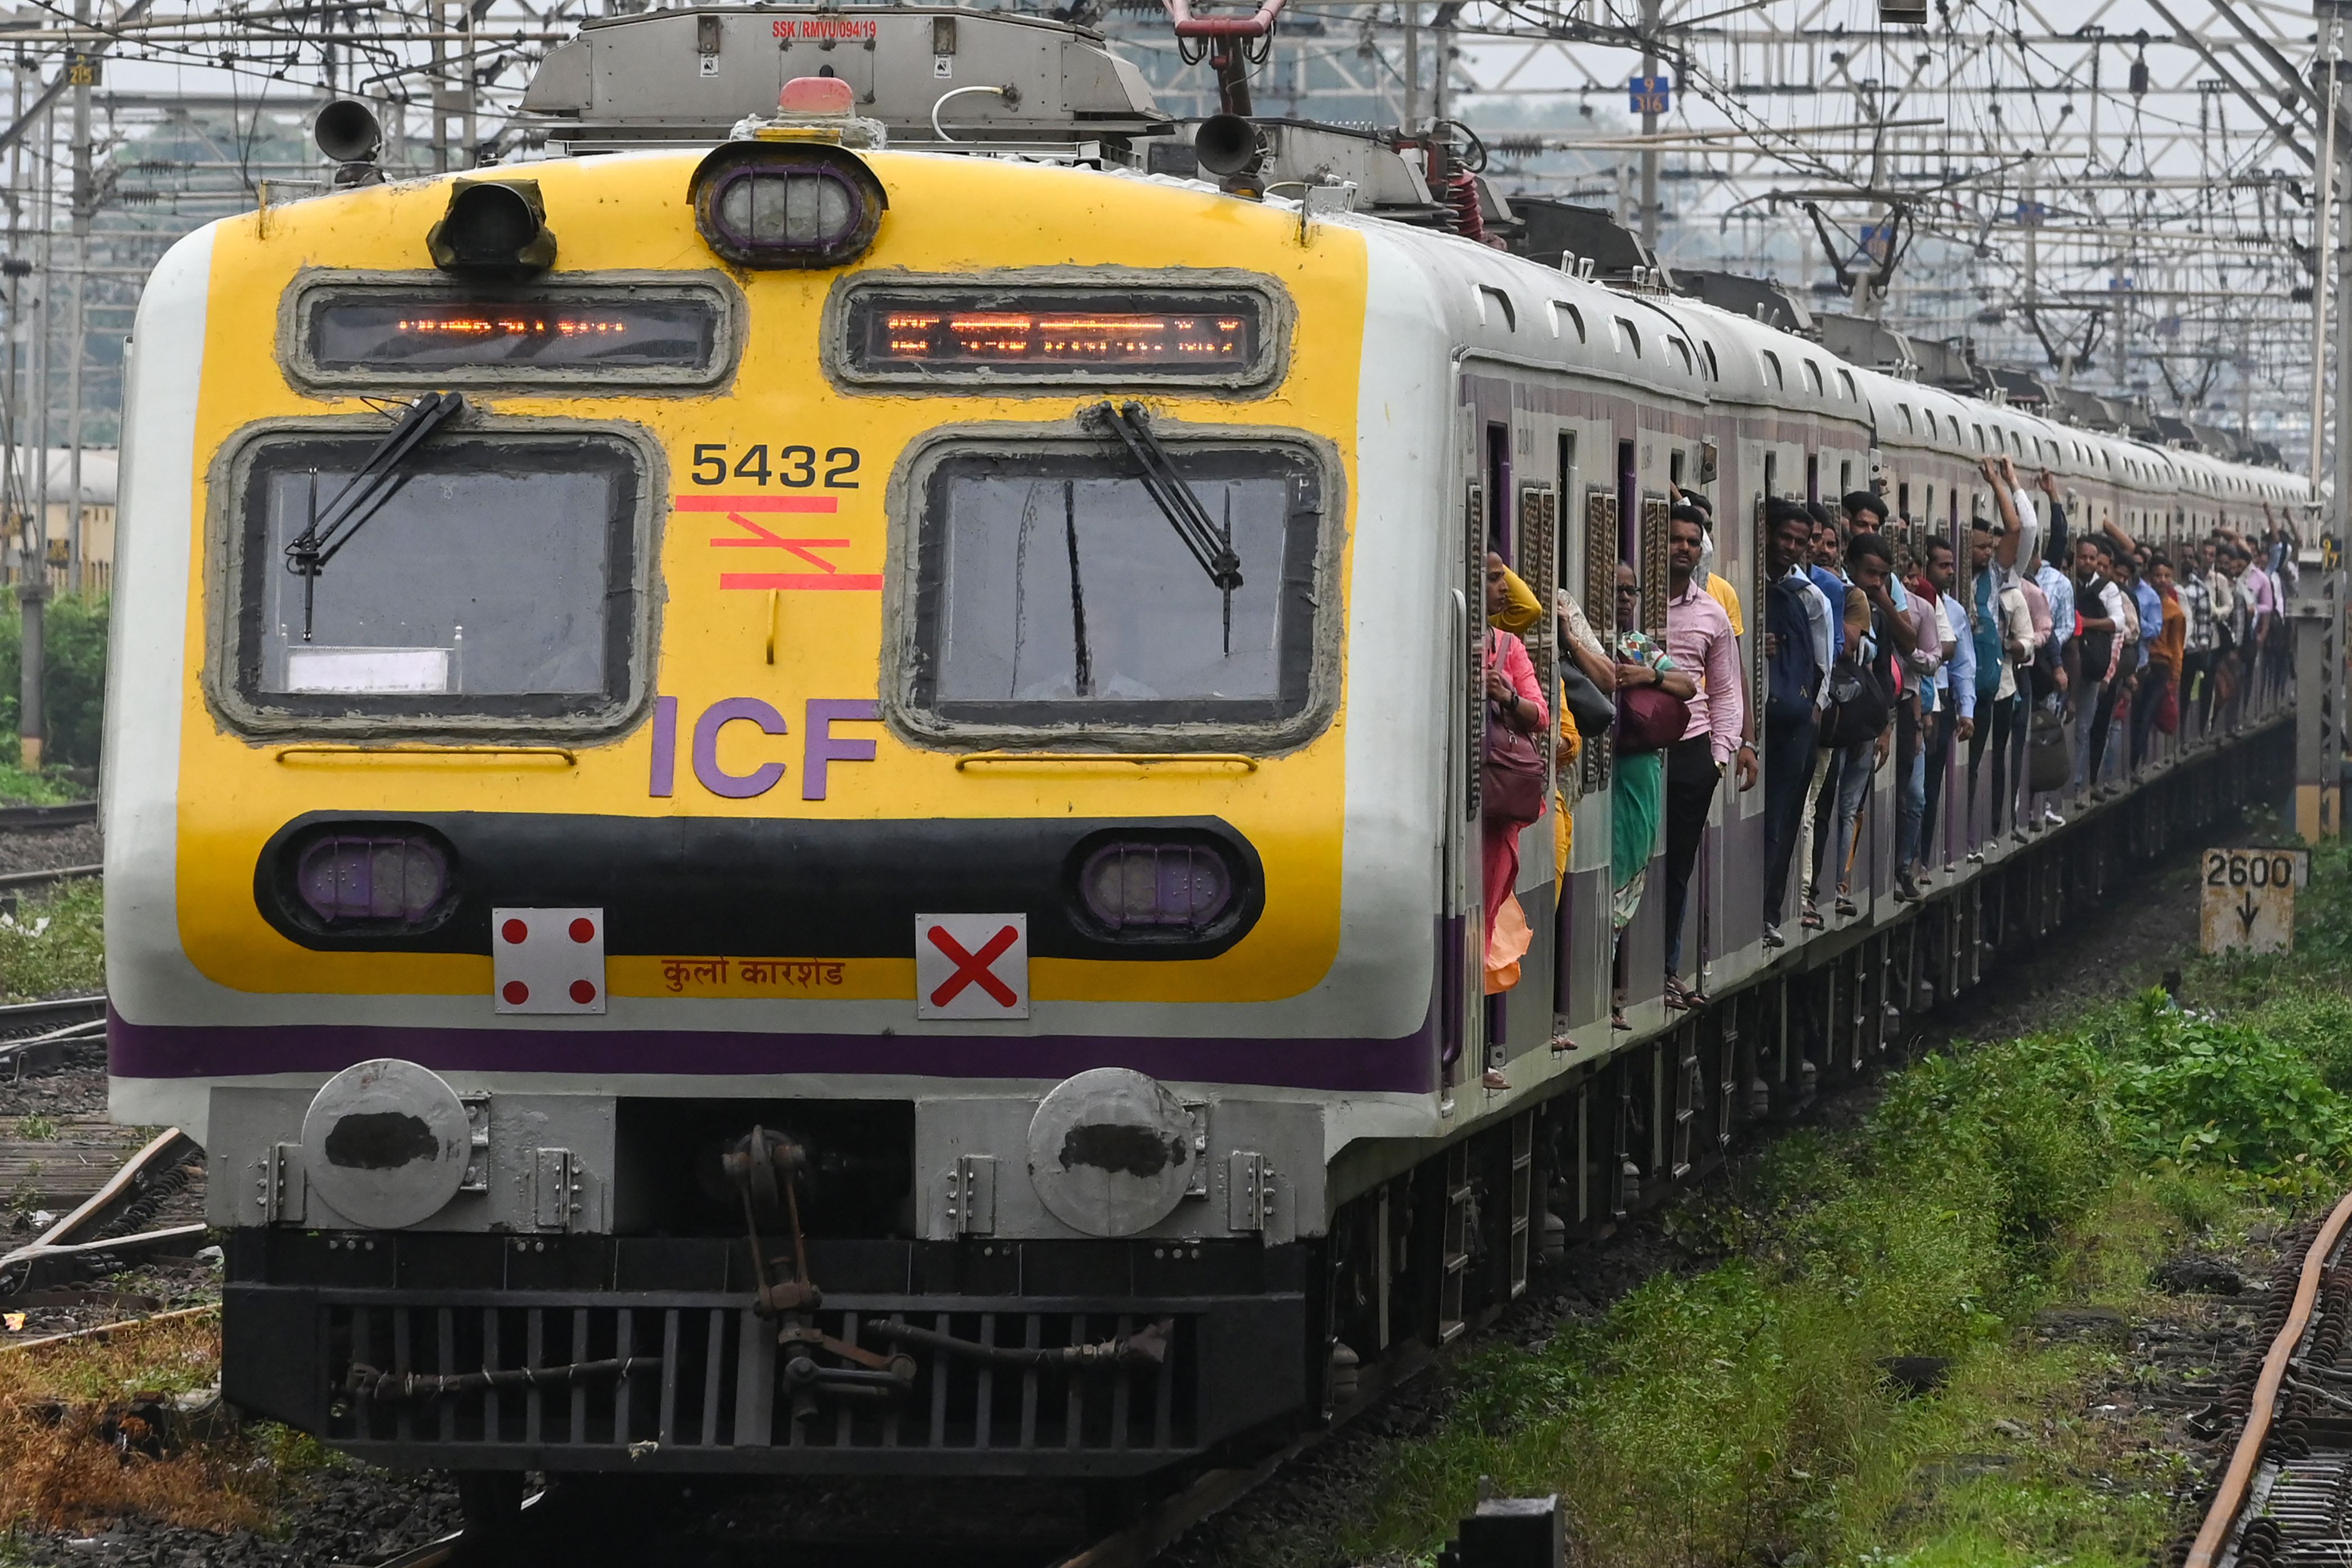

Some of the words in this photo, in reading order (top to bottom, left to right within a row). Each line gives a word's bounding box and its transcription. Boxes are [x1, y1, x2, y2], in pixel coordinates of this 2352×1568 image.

[692, 444, 860, 488] 5432
[649, 696, 885, 800] ICF
[2207, 855, 2292, 888] 2600
